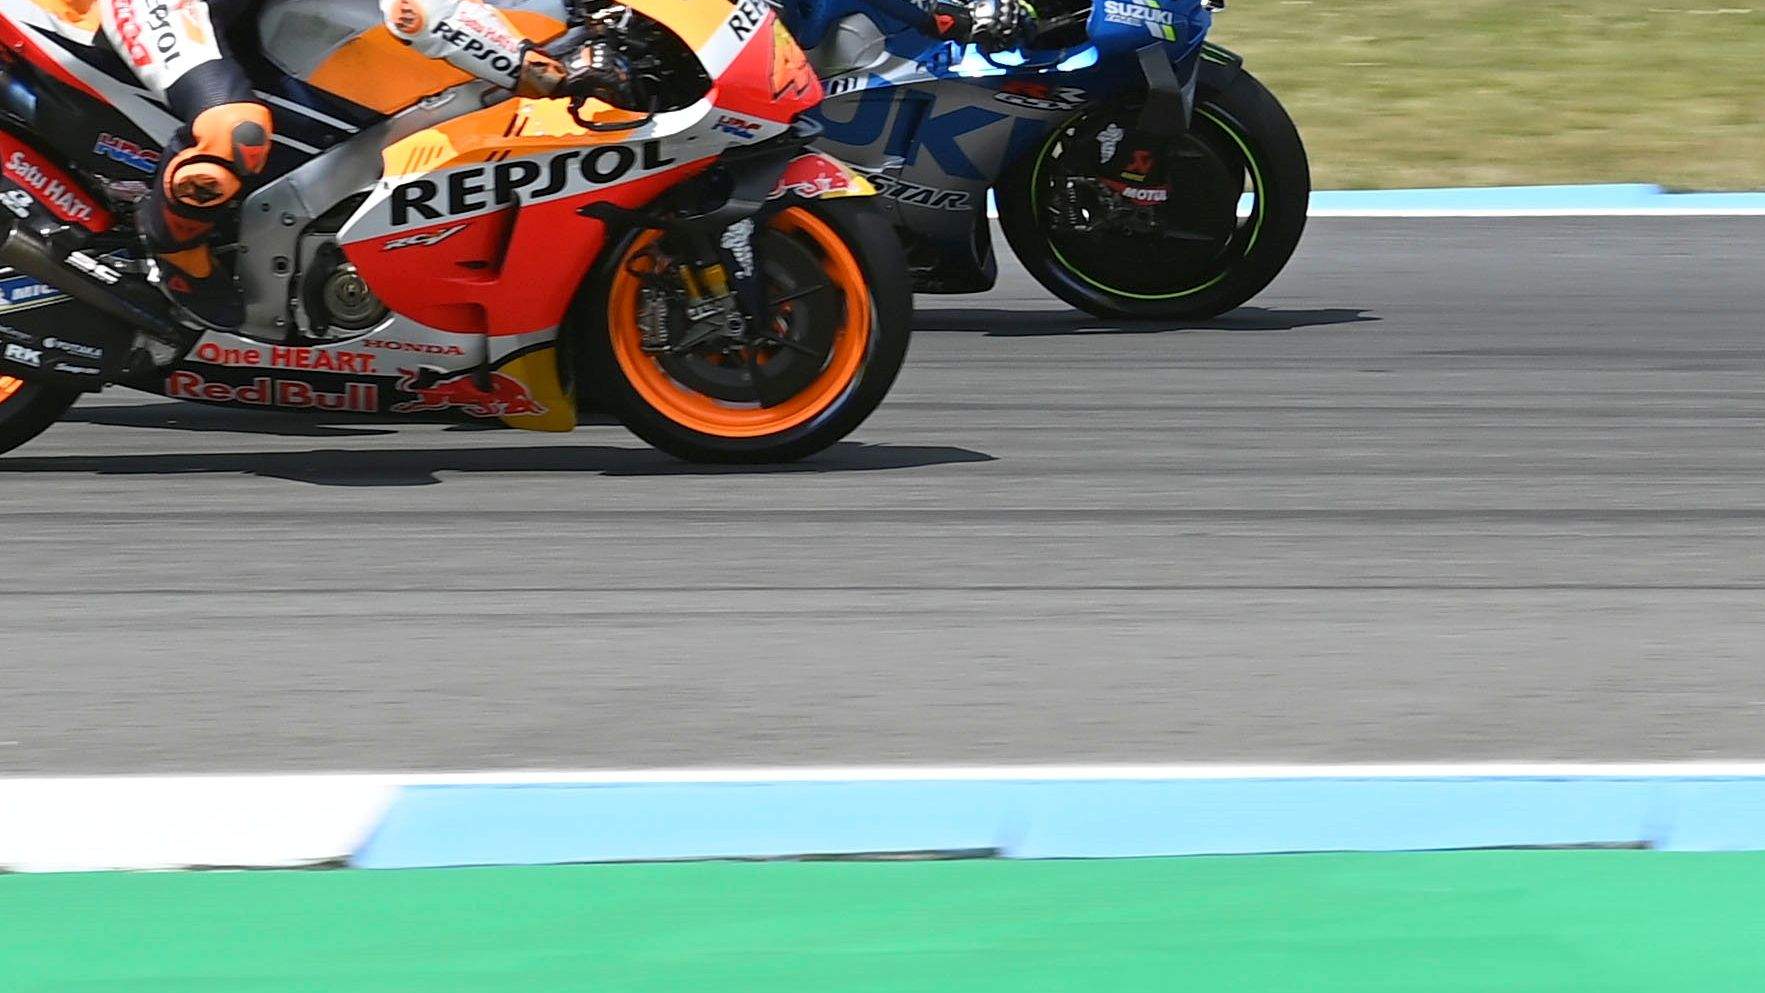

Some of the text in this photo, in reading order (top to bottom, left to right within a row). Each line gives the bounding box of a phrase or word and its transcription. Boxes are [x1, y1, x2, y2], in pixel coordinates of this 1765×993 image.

[1103, 0, 1174, 25] SUZUKI
[8, 151, 47, 190] Satu
[390, 140, 675, 227] REPSOL
[194, 342, 260, 366] One
[362, 338, 466, 356] HONDA
[166, 370, 379, 413] Red Bull
